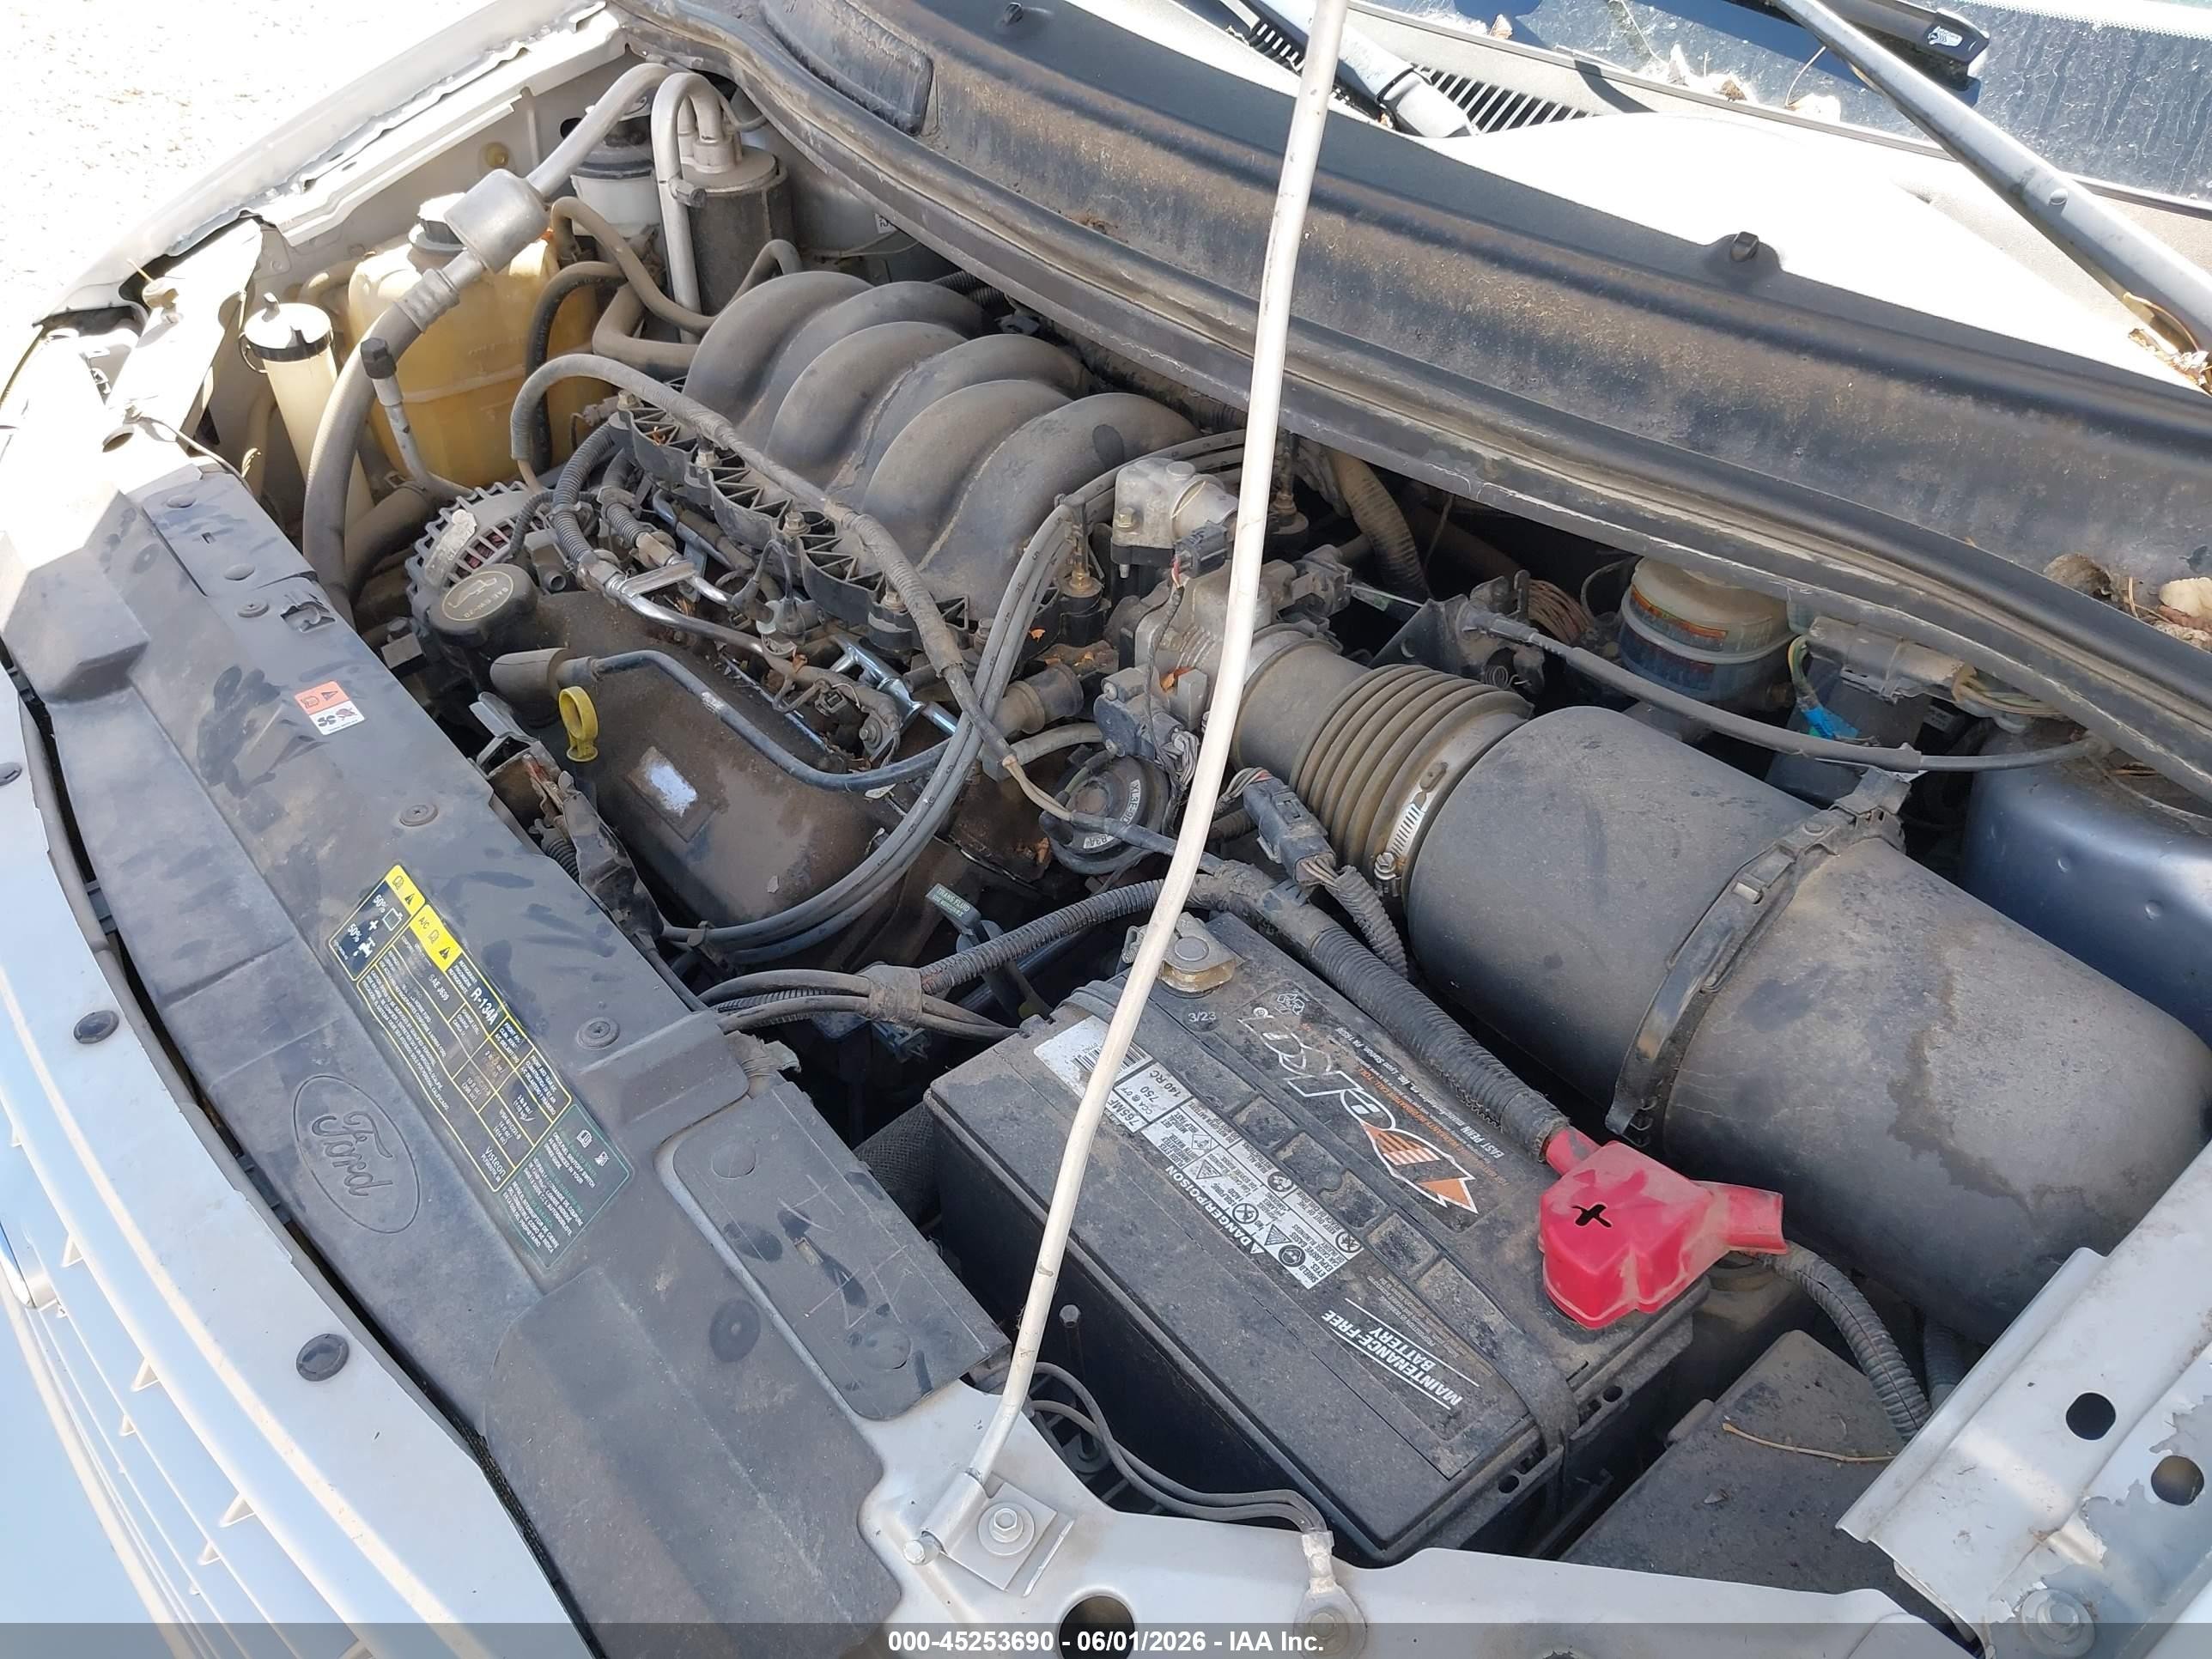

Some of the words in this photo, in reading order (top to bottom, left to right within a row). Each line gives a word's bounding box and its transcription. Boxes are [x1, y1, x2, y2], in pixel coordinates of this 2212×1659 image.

[373, 893, 389, 914] 50%
[936, 886, 957, 902] TRANS
[952, 897, 971, 912] FLUID
[418, 915, 429, 930] A/C
[346, 922, 362, 943] 50%
[428, 973, 441, 989] SAE
[435, 985, 450, 1002] J639
[469, 986, 500, 1025] R-134A
[1188, 1011, 1217, 1023] 3/23
[1351, 1038, 1364, 1048] PA
[1381, 1060, 1399, 1074] Lyon
[1148, 1068, 1167, 1085] RC
[1139, 1085, 1159, 1102] 750
[1163, 1081, 1182, 1097] 140
[1129, 1093, 1142, 1103] @
[1106, 1096, 1139, 1126] 765MF
[1137, 1100, 1154, 1115] CCA
[1237, 1016, 1479, 1215] Deka
[1159, 1117, 1173, 1129] GET
[1166, 1115, 1188, 1134] MEDICAL
[1182, 1120, 1199, 1134] HELP
[1215, 1127, 1228, 1138] NOT
[1224, 1134, 1235, 1143] DO
[1230, 1131, 1240, 1139] DO
[1460, 1123, 1486, 1144] PENN
[311, 1110, 394, 1197] Ford
[1158, 1141, 1172, 1155] EYES
[1160, 1134, 1192, 1163] IMMEDIATELY
[1480, 1140, 1504, 1159] EAST
[483, 1145, 507, 1177] Visteon
[1168, 1152, 1186, 1167] FLUSH
[1245, 1153, 1257, 1164] ALL
[1232, 1167, 1251, 1183] SEVERE
[1254, 1161, 1268, 1174] READ
[1209, 1182, 1235, 1205] SULFURIC
[1226, 1187, 1242, 1200] ACID
[1164, 1164, 1252, 1246] DANGER/POISON
[1297, 1199, 1310, 1210] THE
[1305, 1207, 1316, 1216] OF
[1312, 1213, 1325, 1224] OUT
[1317, 1209, 1328, 1218] OF
[1321, 1221, 1337, 1235] KEEP
[1323, 1214, 1342, 1231] REACH
[1288, 1231, 1308, 1248] GASES
[1291, 1223, 1317, 1246] BLINDNESS
[1304, 1245, 1334, 1272] EXPLOSIVE
[1314, 1243, 1331, 1258] CAUSE
[1327, 1255, 1340, 1267] CAN
[1297, 1264, 1319, 1283] SHIELD
[1367, 1325, 1437, 1372] BATTERY
[1319, 1309, 1463, 1407] MAINTENANCE-FREE
